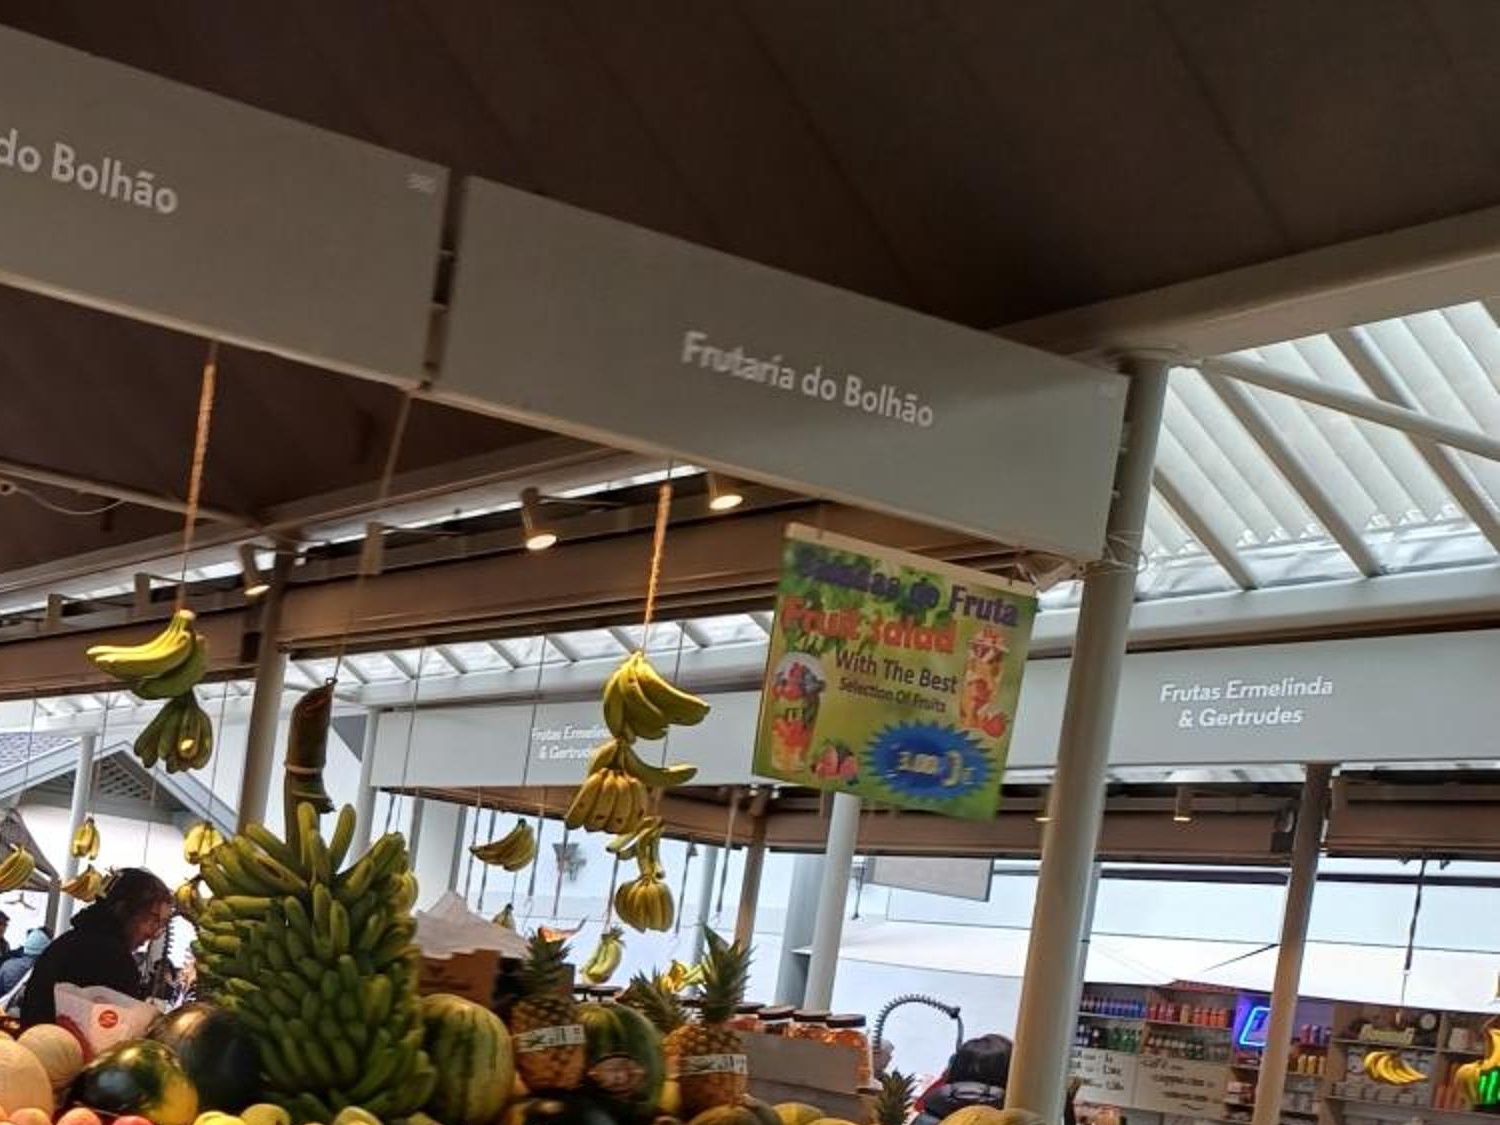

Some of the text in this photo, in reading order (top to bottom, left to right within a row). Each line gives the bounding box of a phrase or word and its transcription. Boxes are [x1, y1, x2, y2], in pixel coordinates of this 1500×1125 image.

[51, 142, 178, 214] Bolhão
[681, 331, 933, 427] Frutaria do Bolhão
[950, 584, 1020, 628] Fruta
[835, 648, 959, 696] With The Best
[1160, 675, 1333, 703] Frutas Ermelinda
[1178, 704, 1304, 728] & Gertrudes
